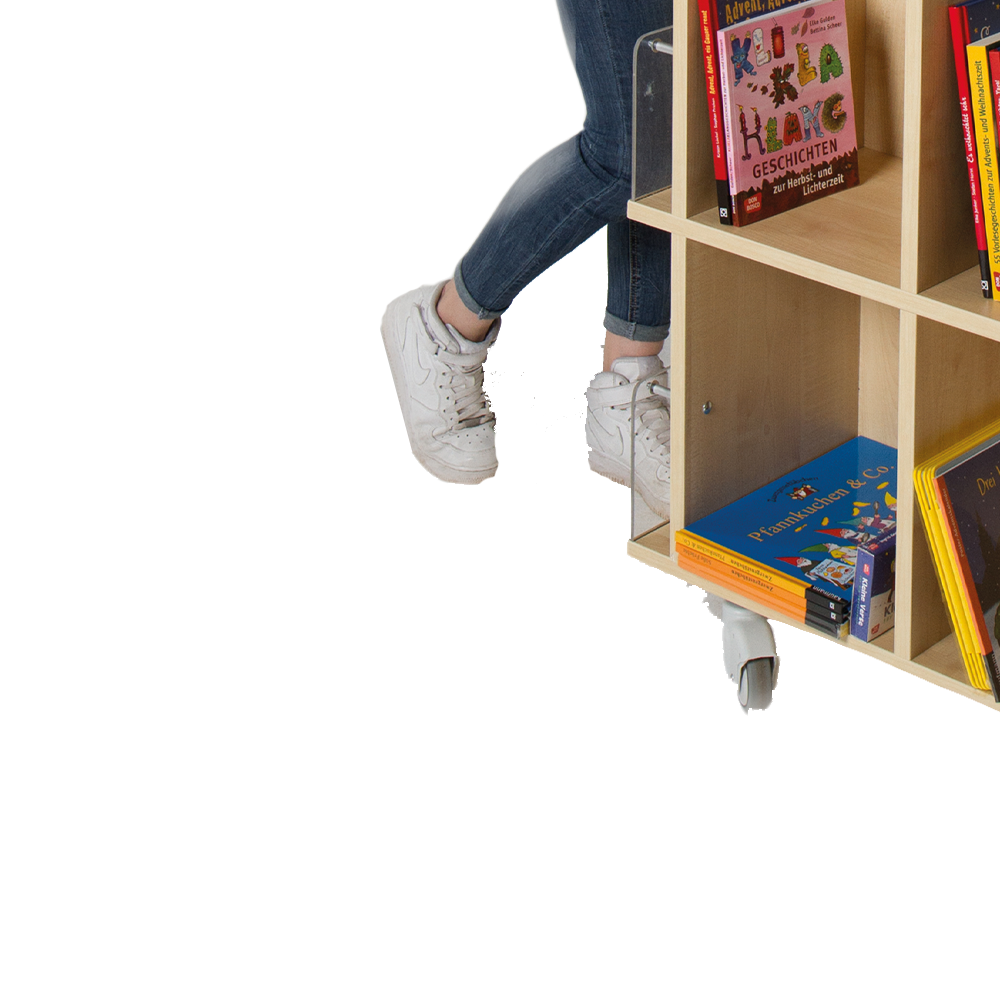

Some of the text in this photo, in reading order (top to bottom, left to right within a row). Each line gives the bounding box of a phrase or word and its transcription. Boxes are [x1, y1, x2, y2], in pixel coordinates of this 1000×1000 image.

[974, 60, 987, 118] Weihnachtszeit
[752, 138, 838, 179] GESCHICHTEN
[981, 136, 993, 168] Advents-
[773, 165, 833, 195] zur Herbst- und
[803, 173, 845, 196] Lichterzeit
[986, 184, 1000, 254] Vorlesegeschichten
[977, 472, 996, 497] Drei
[748, 465, 895, 543] Pfannkuchen & Co.
[861, 577, 869, 602] Kleine
